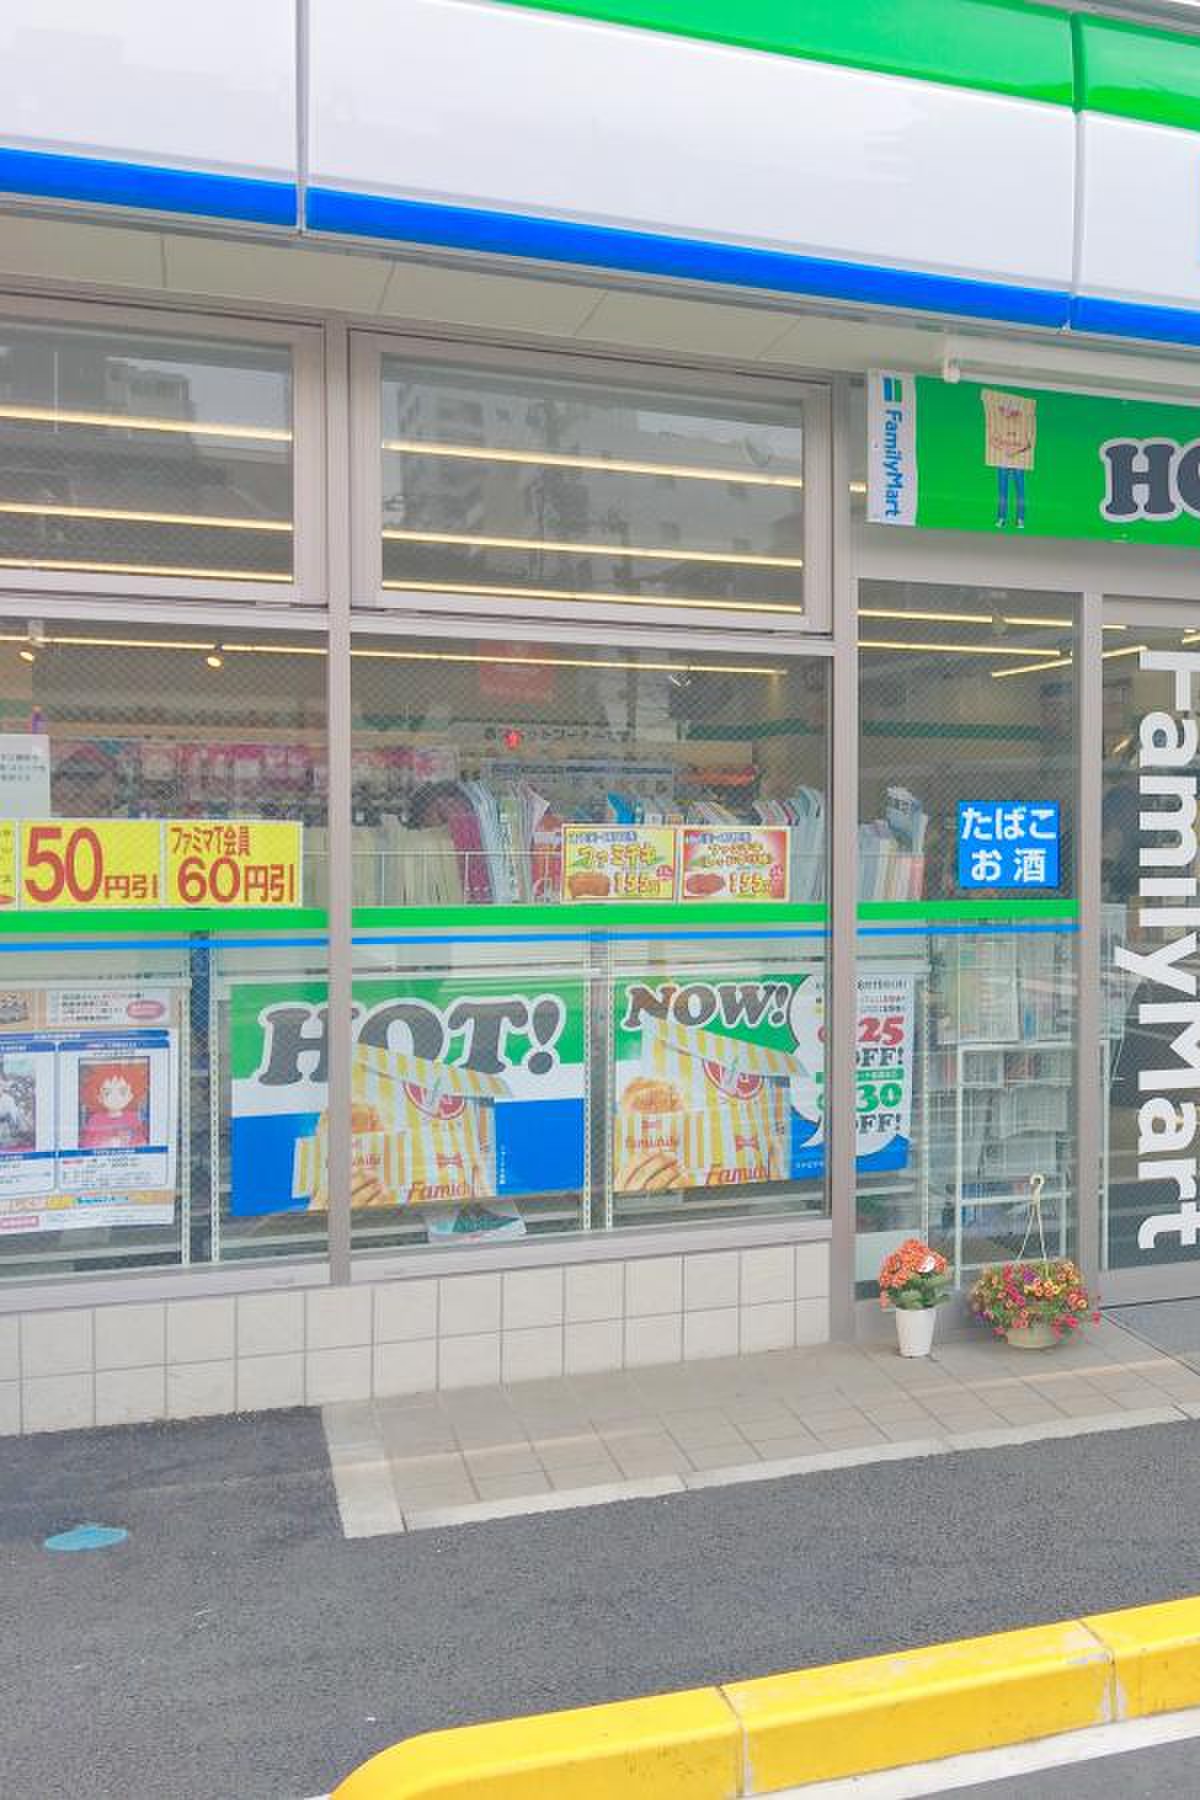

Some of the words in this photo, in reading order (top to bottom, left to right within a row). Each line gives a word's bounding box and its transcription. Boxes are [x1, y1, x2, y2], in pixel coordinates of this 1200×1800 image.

[882, 409, 904, 518] FamilyMart
[170, 826, 251, 857] ファミマT会員
[961, 806, 1057, 840] たばこ
[24, 827, 159, 903] 50円引
[177, 855, 296, 903] 60円引
[971, 848, 1047, 882] お酒
[623, 984, 790, 1028] NOW!
[257, 999, 561, 1087] HOT!
[856, 1047, 904, 1067] FF!
[856, 1113, 903, 1134] FF!
